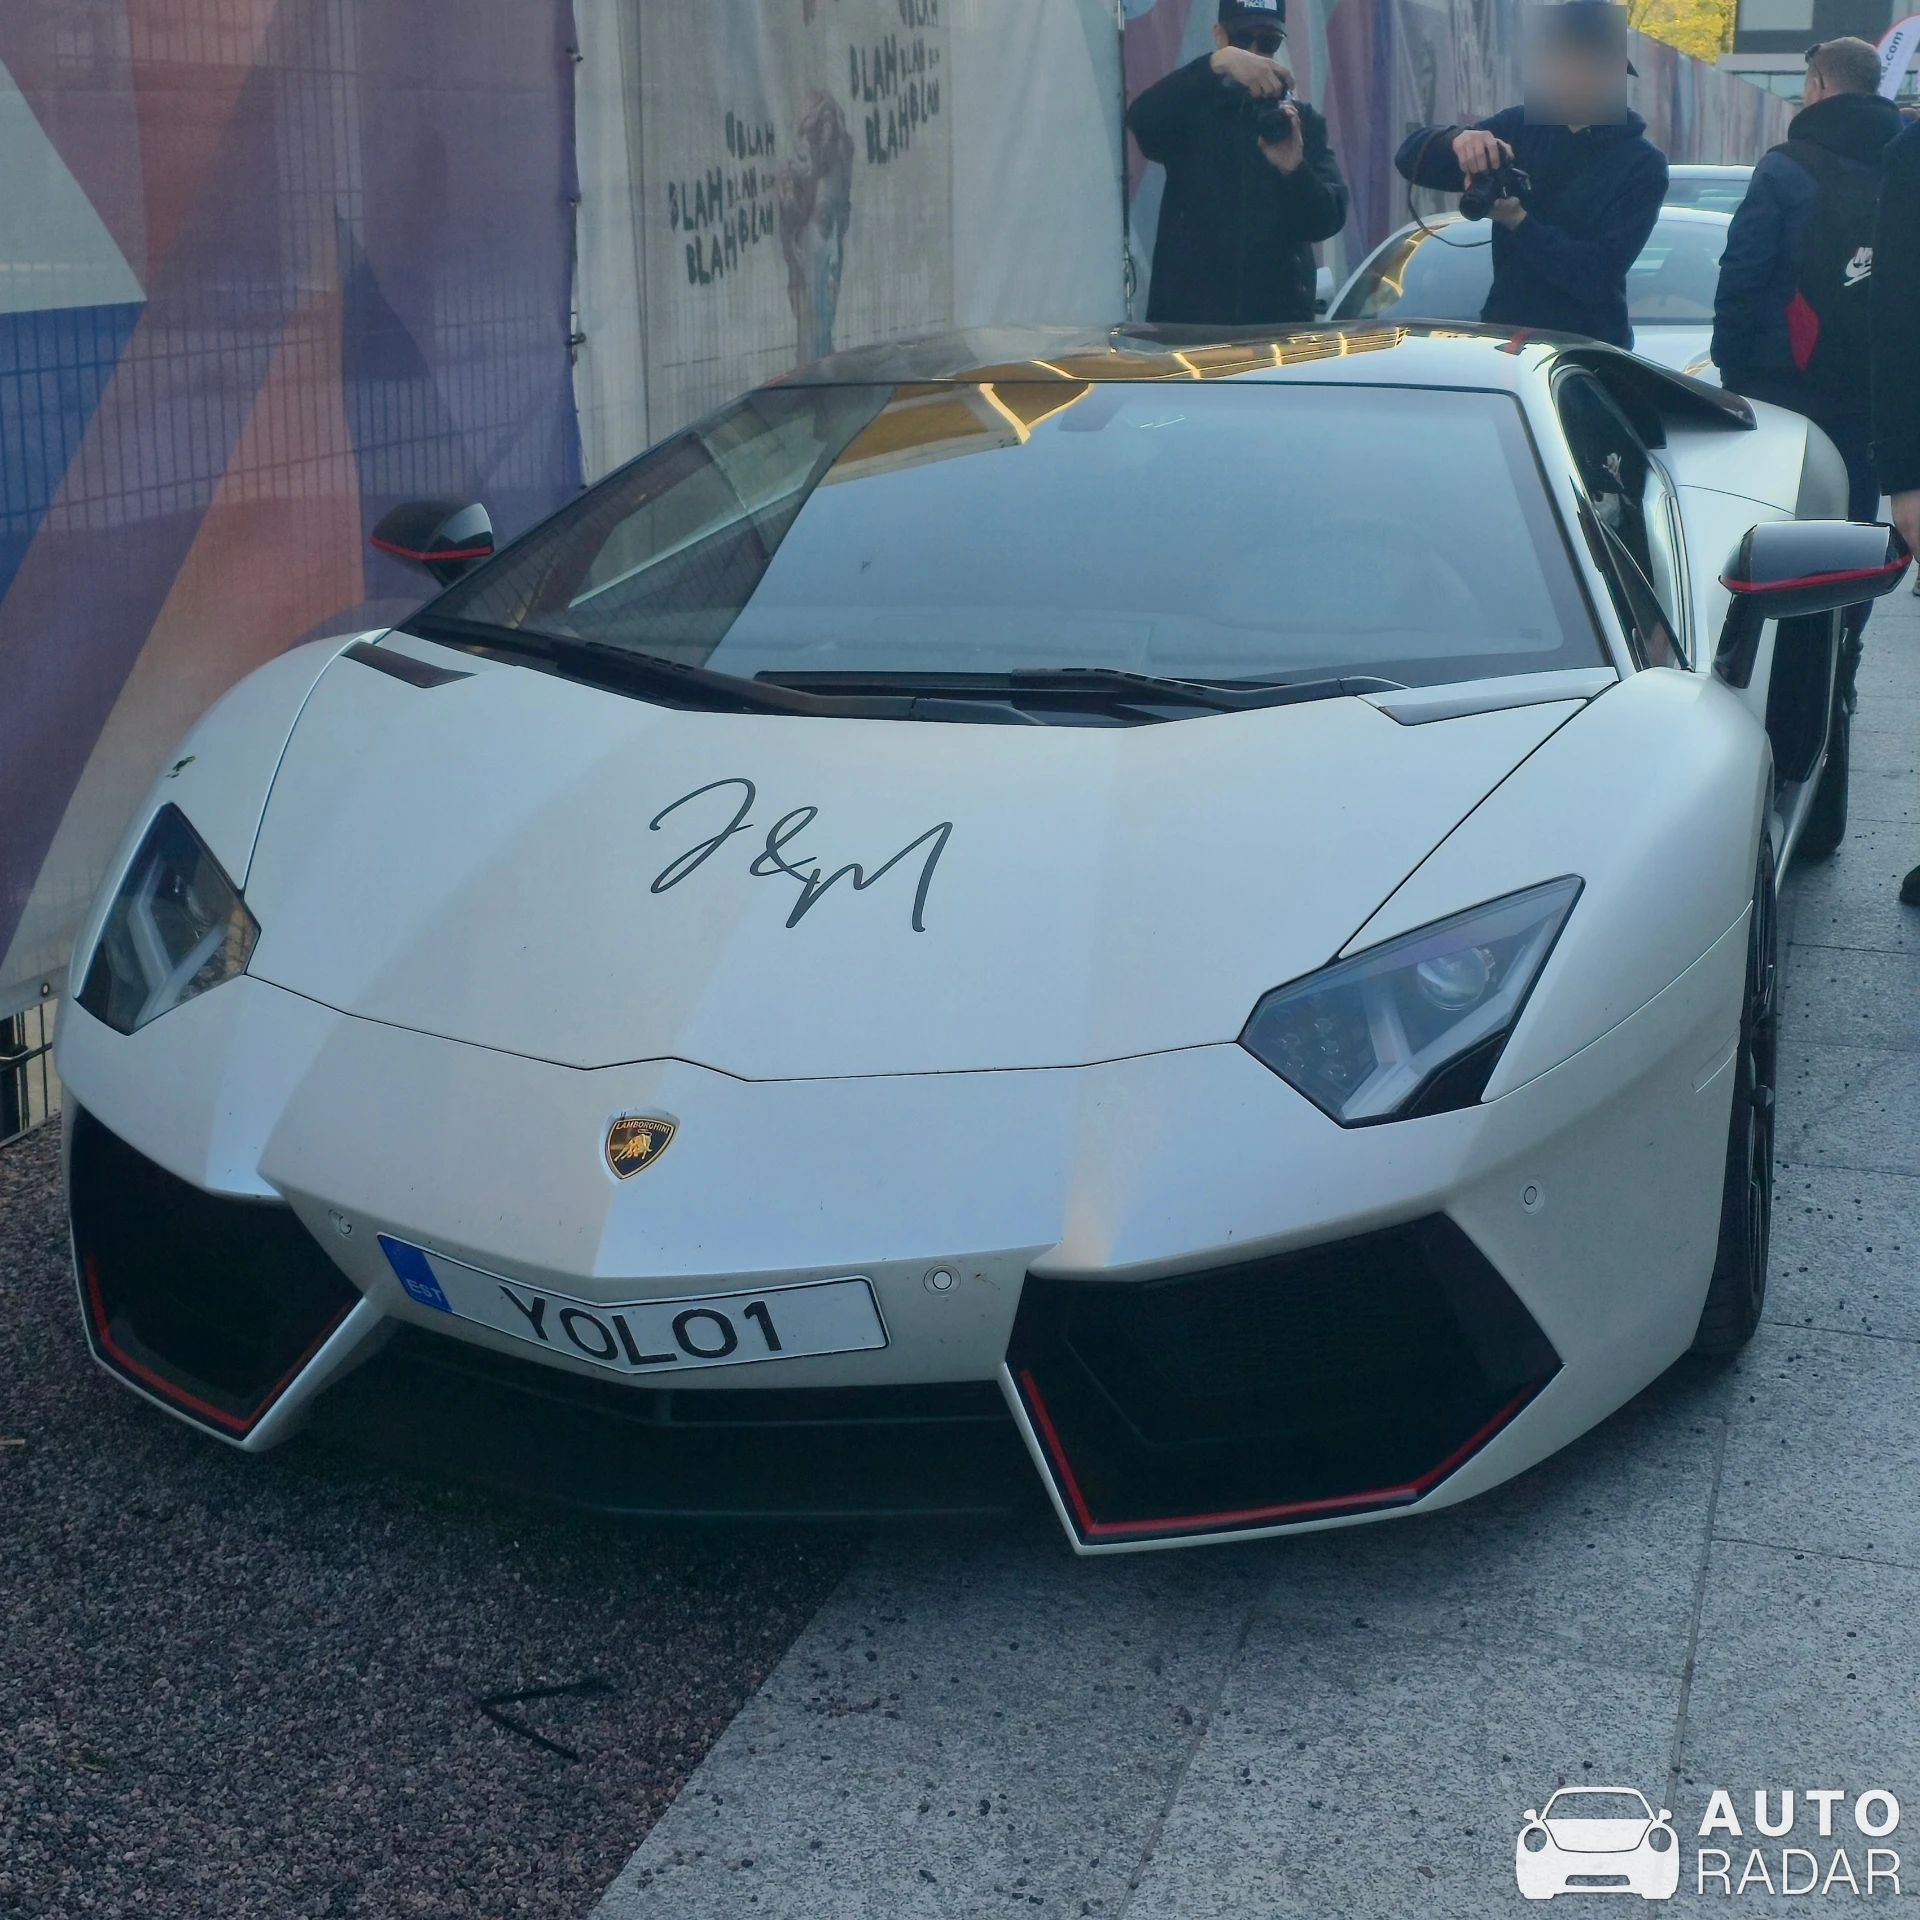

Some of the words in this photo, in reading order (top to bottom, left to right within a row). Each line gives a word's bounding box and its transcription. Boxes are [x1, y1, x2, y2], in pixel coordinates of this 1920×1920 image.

[850, 33, 898, 102] BLAH
[866, 107, 909, 165] BLAH
[669, 162, 723, 232] BLAH
[685, 225, 737, 286] BLAH
[615, 1120, 670, 1135] LAMBORGHINI
[405, 1278, 443, 1303] EST
[498, 1284, 782, 1366] YOLO1
